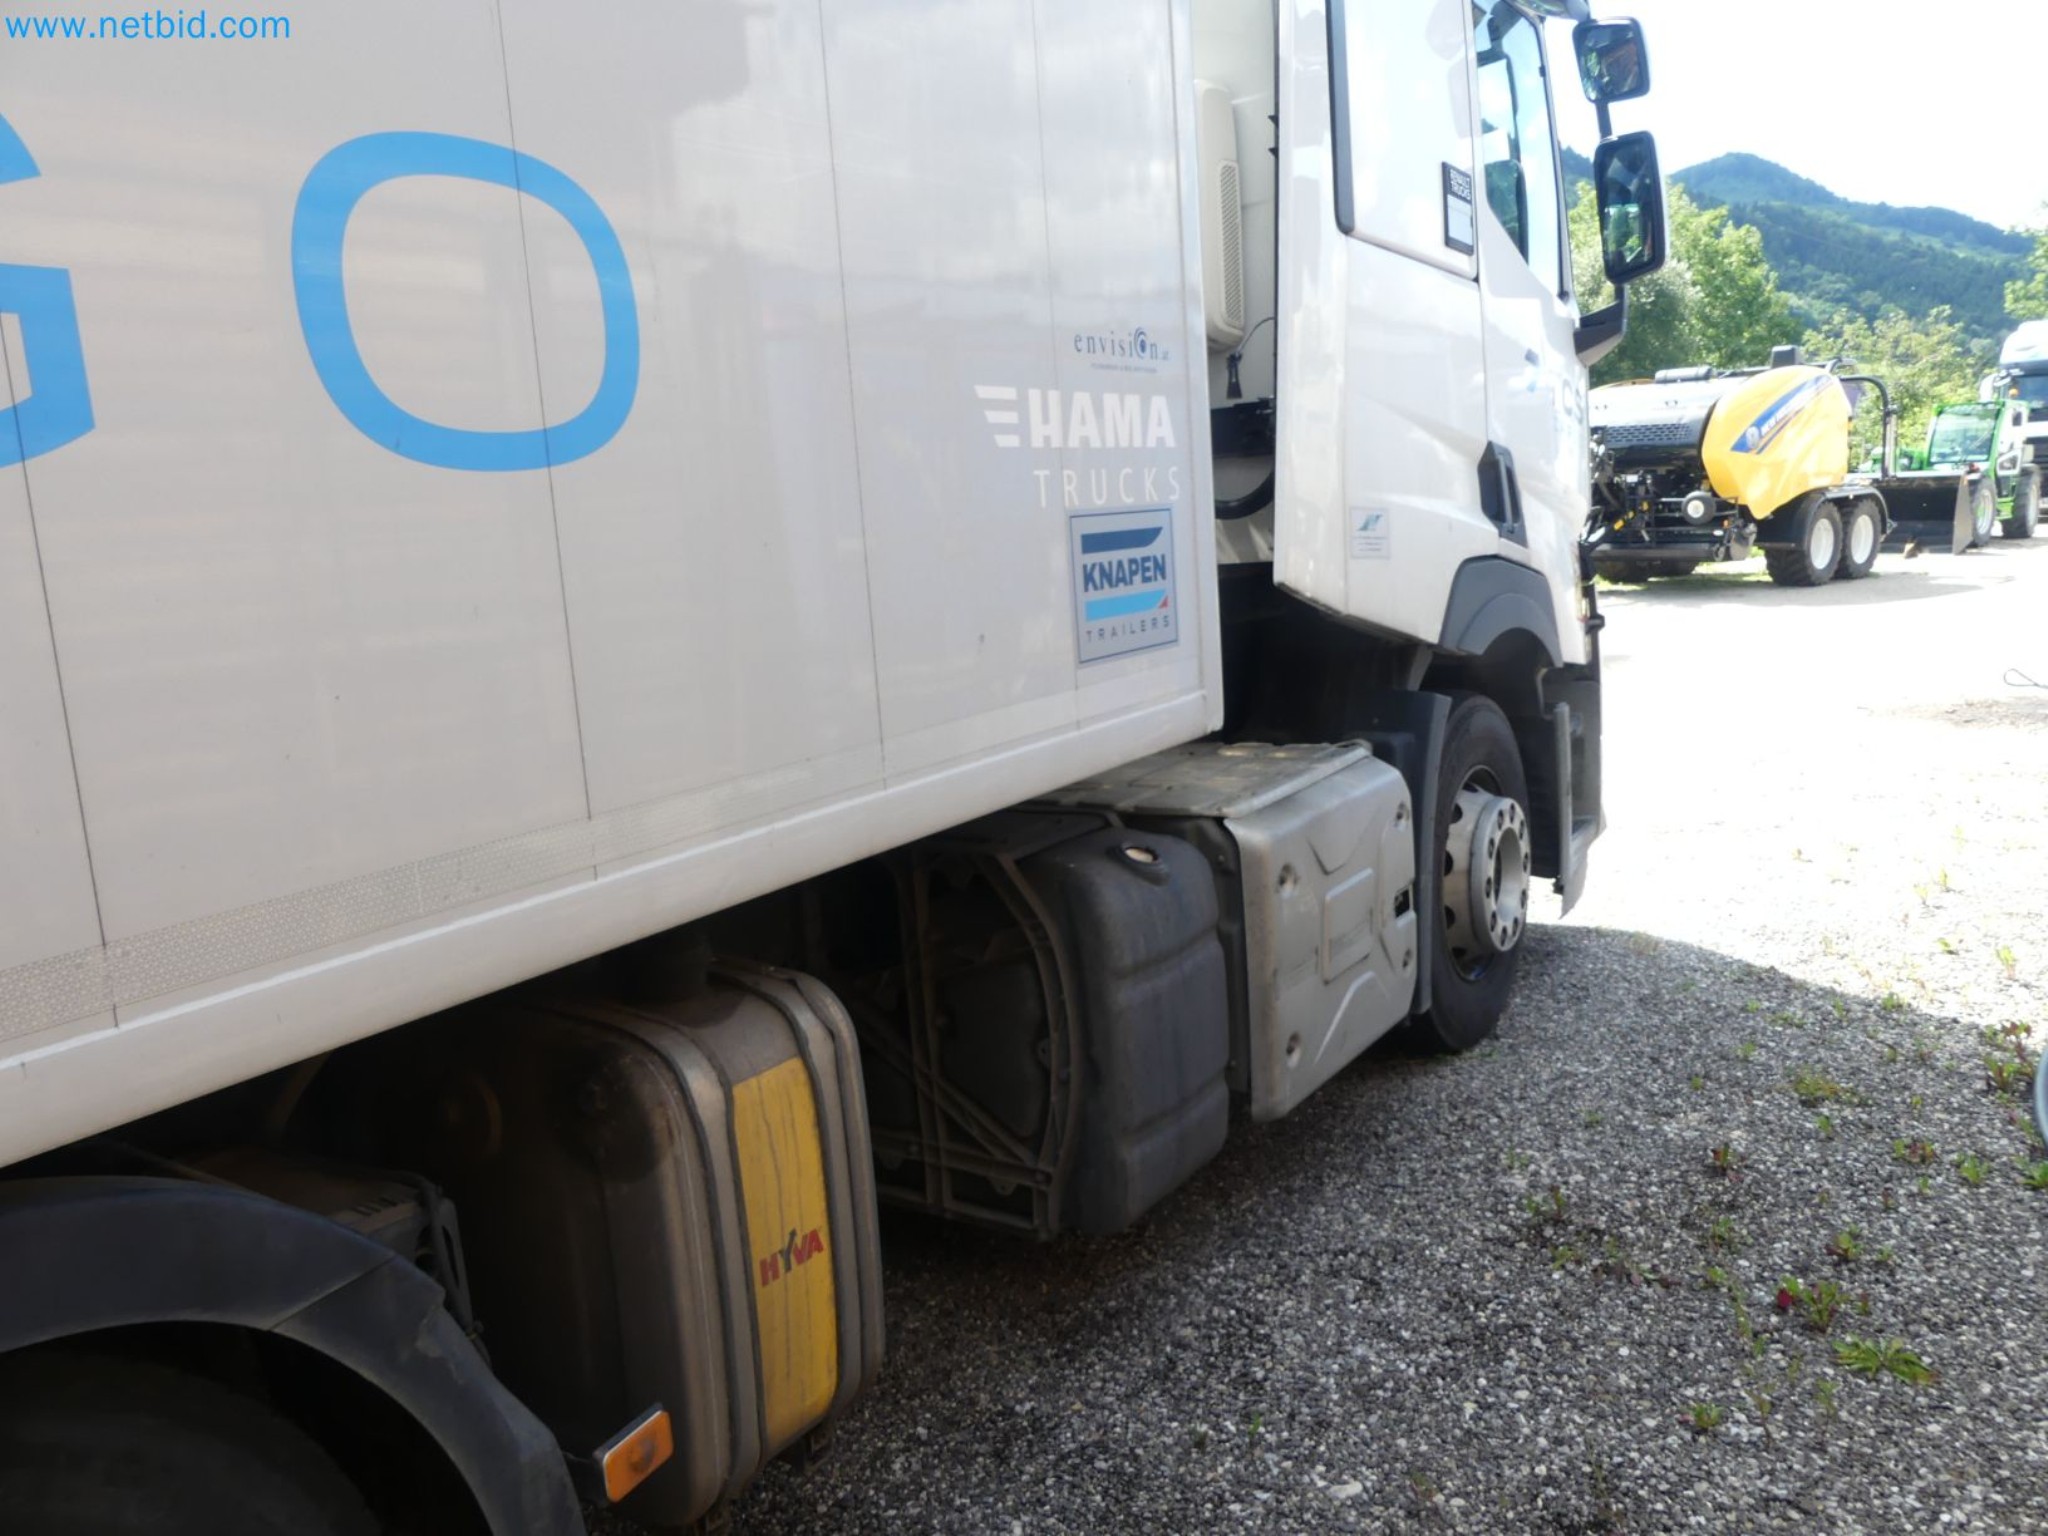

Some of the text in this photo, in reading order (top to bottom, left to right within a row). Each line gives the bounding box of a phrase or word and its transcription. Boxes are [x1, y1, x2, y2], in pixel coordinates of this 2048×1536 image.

[1027, 388, 1177, 449] HAMA
[1033, 466, 1181, 508] TRUCKS
[1082, 553, 1167, 593] KNAPEN
[1086, 615, 1170, 643] TRAILERS
[759, 1227, 824, 1288] HYVA
